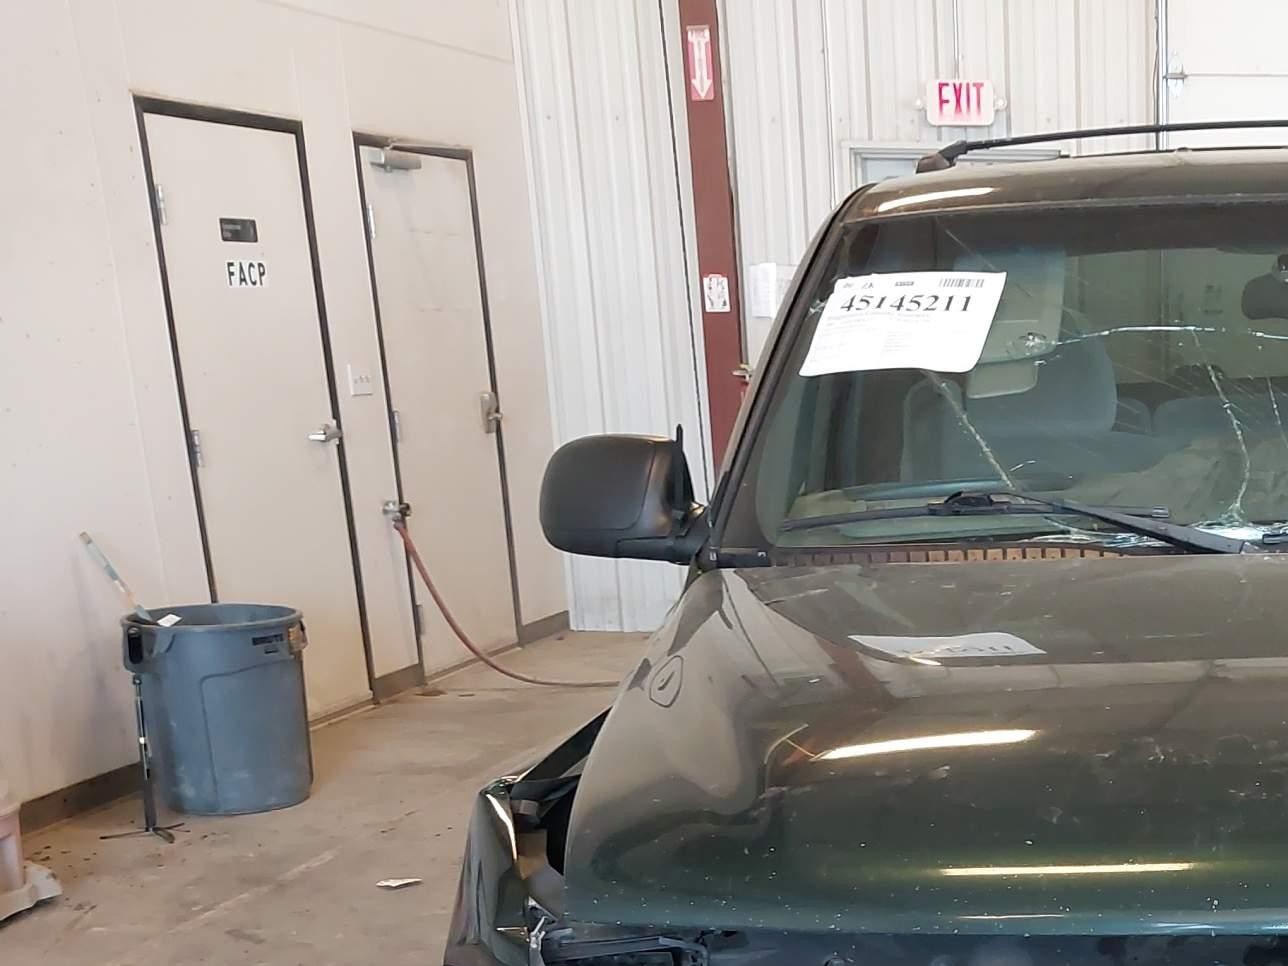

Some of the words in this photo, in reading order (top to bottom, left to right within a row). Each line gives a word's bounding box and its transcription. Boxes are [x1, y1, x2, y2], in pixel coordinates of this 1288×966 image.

[938, 82, 984, 119] EXIT
[226, 261, 266, 286] FACP
[840, 294, 972, 312] 45145211
